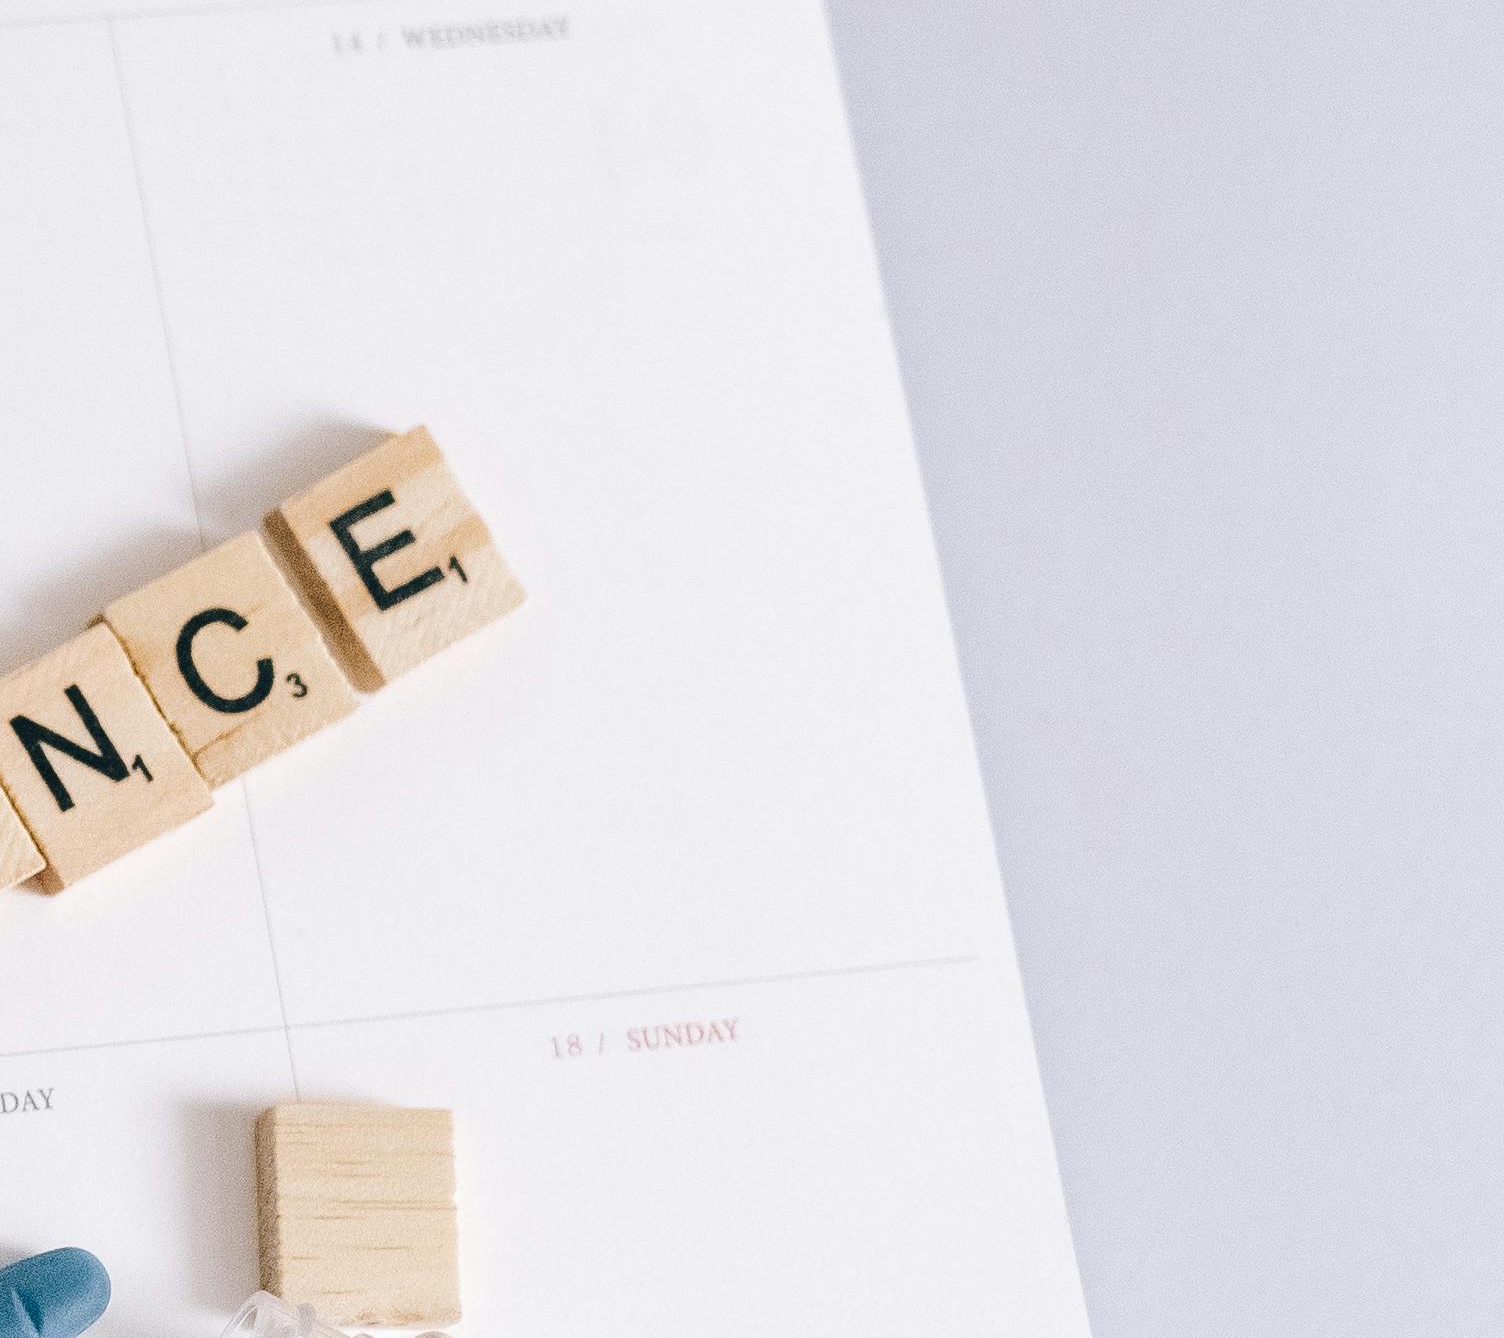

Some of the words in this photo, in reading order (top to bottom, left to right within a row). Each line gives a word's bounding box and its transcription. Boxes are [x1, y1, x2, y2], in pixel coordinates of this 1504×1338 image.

[401, 16, 569, 49] WEDNESDAY
[448, 555, 468, 583] 1
[285, 673, 308, 699] 3
[131, 754, 153, 782] 1
[550, 1034, 584, 1059] 18
[625, 1018, 738, 1051] SUNDAY
